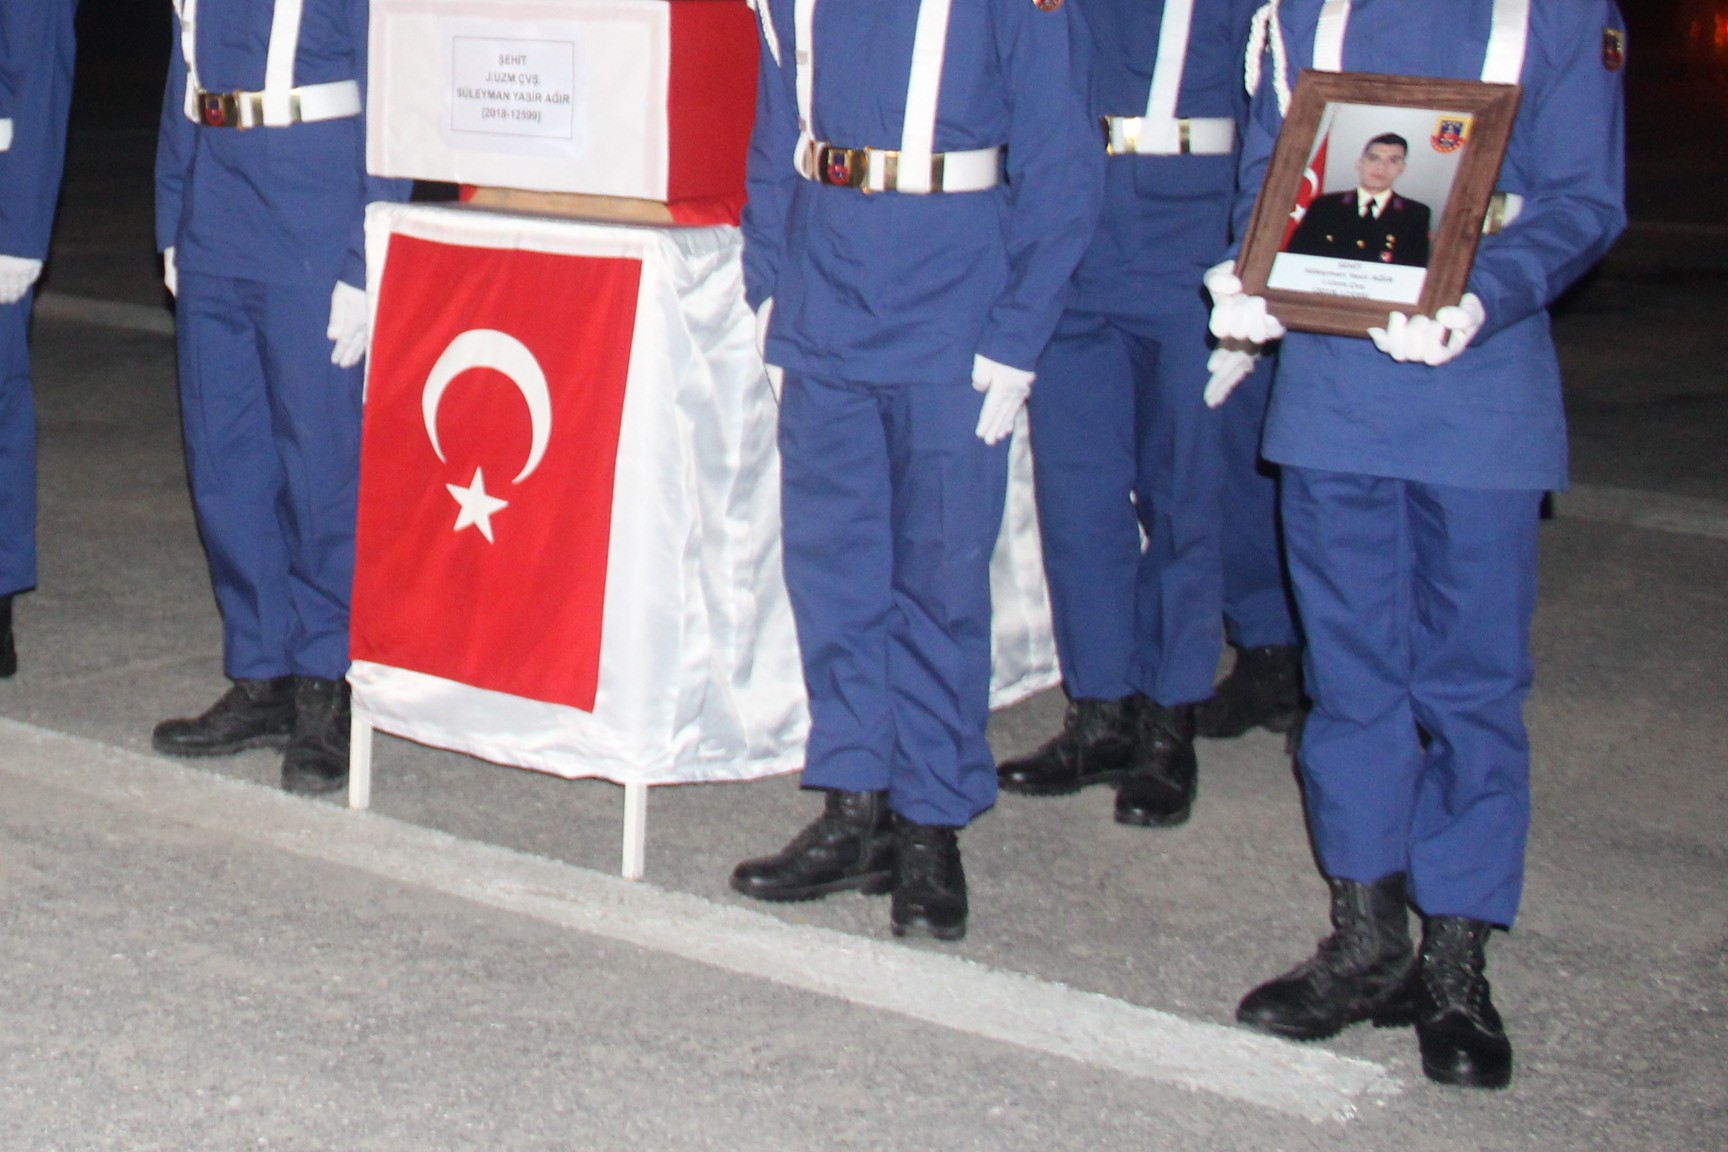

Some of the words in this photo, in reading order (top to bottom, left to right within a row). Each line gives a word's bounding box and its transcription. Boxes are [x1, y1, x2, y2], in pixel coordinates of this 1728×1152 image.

[498, 53, 527, 66] ŞEHİT
[456, 87, 510, 100] SÜLEYMAN
[512, 89, 543, 103] YASİR
[545, 91, 570, 104] AĞIR
